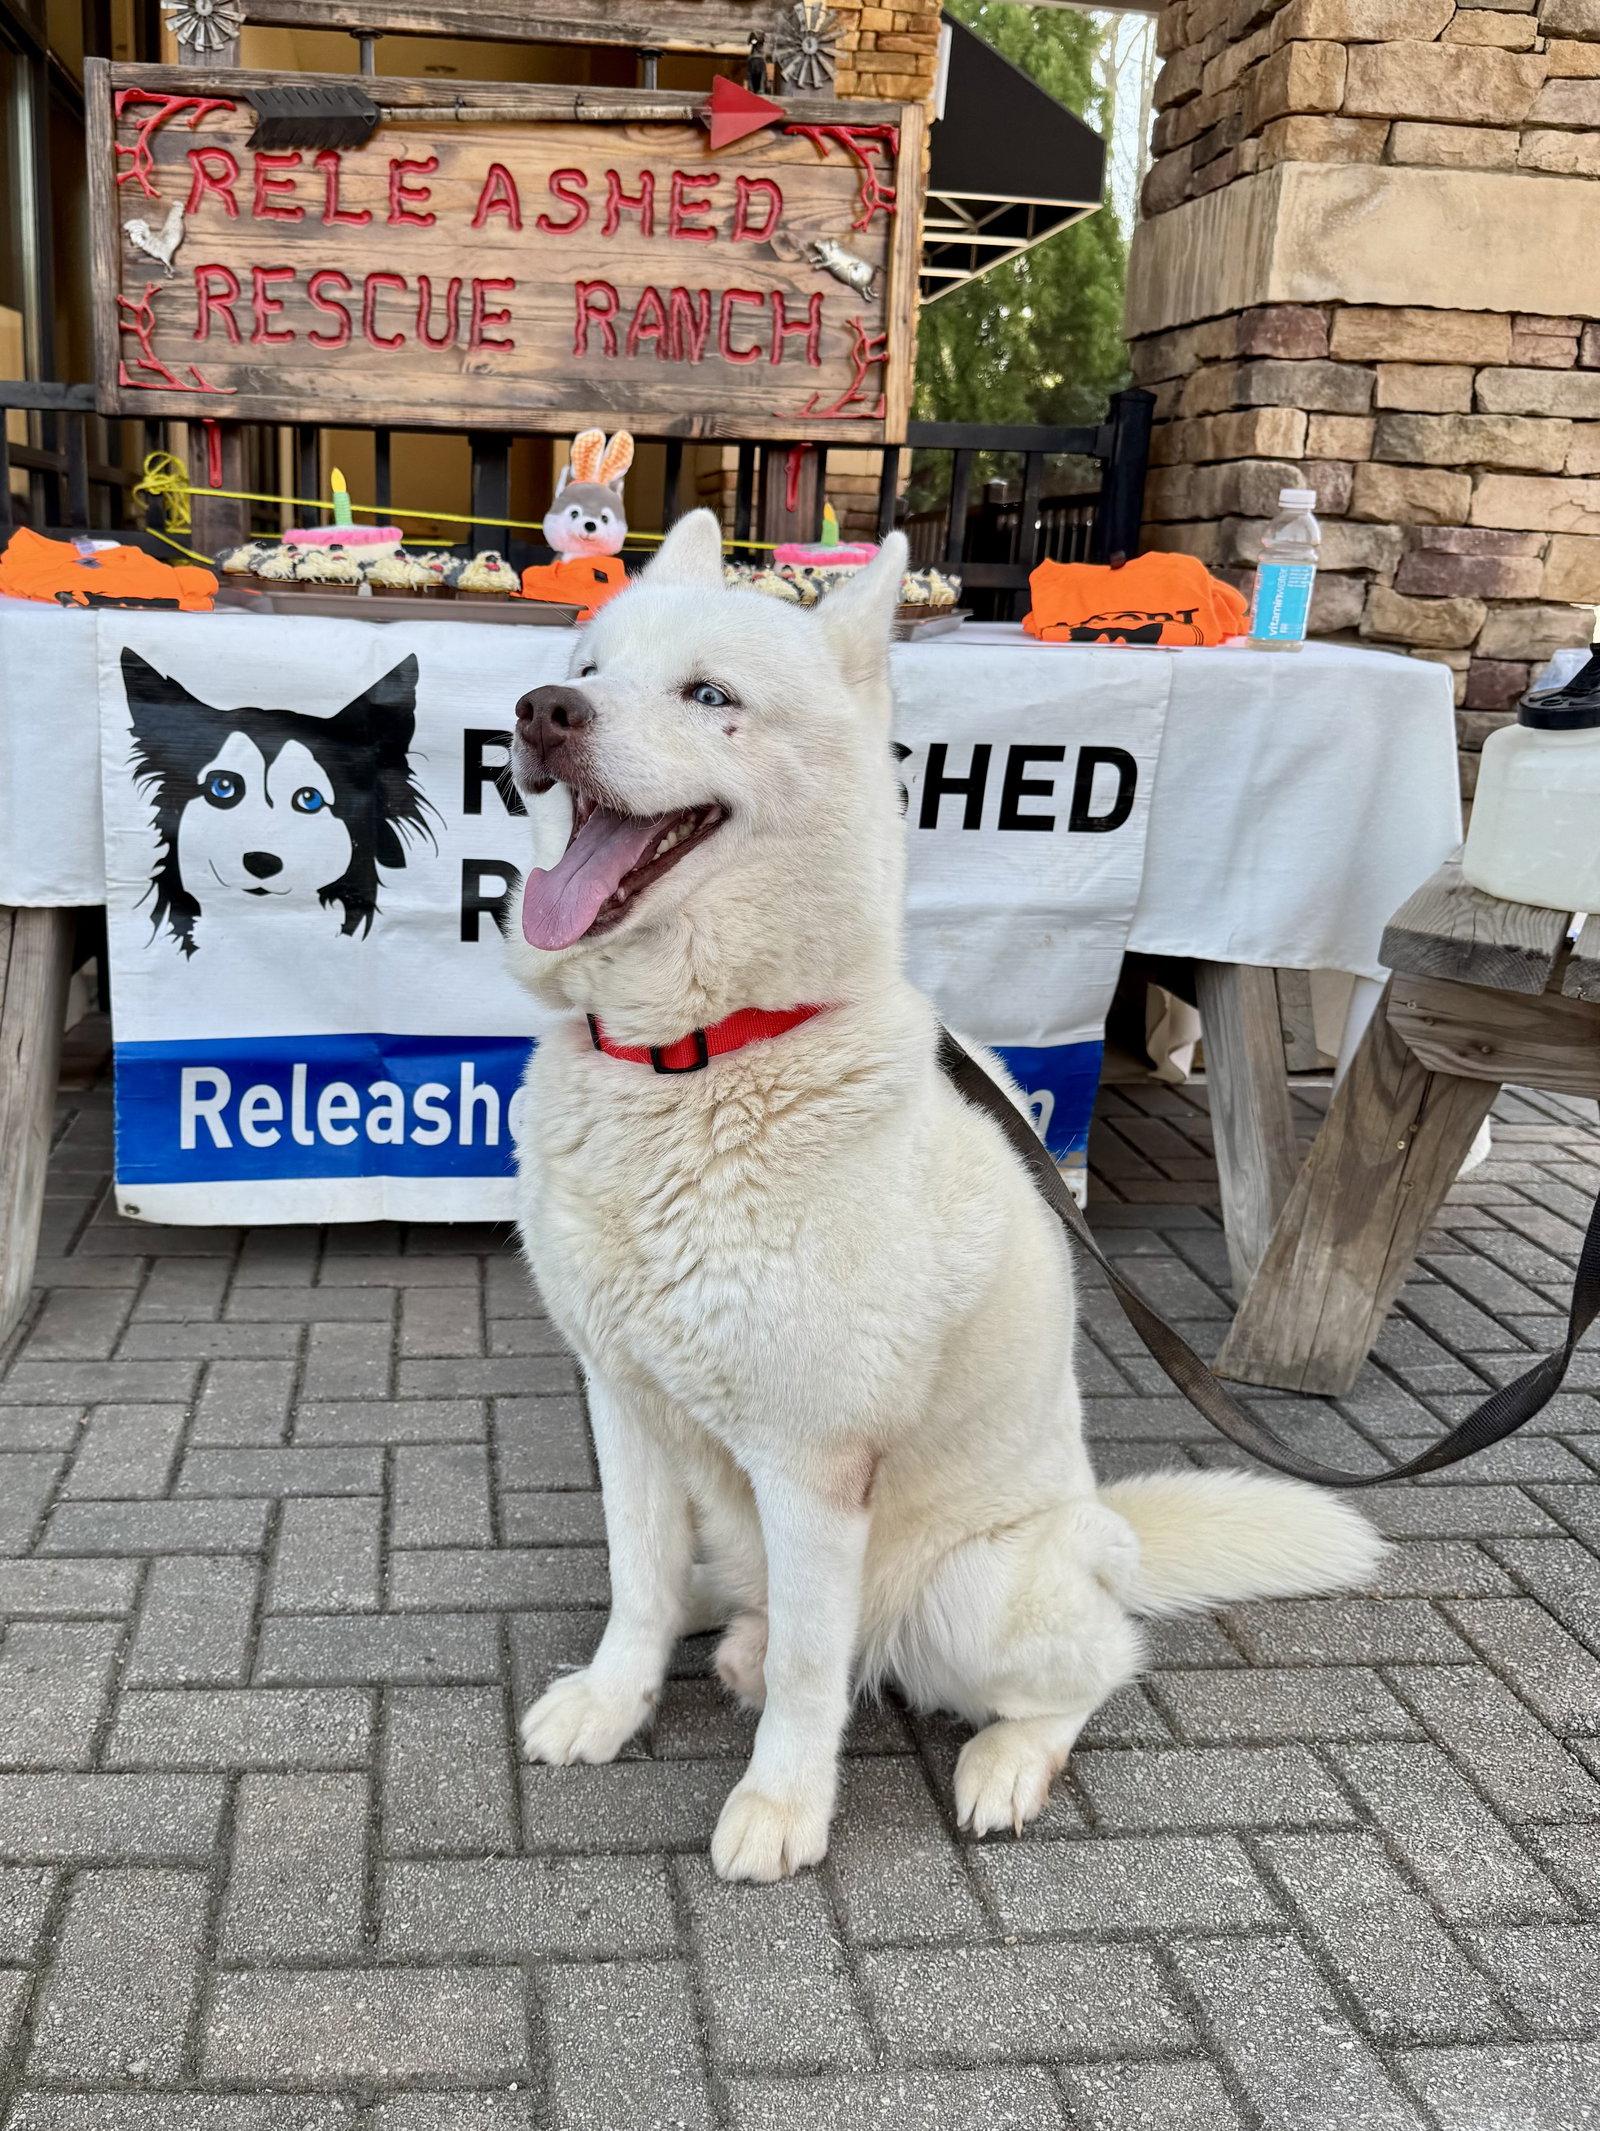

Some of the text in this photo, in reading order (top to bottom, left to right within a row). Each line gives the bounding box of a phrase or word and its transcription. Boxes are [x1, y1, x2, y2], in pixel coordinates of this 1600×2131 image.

[194, 263, 824, 368] RESCUE RANCH
[890, 741, 1138, 833] HED
